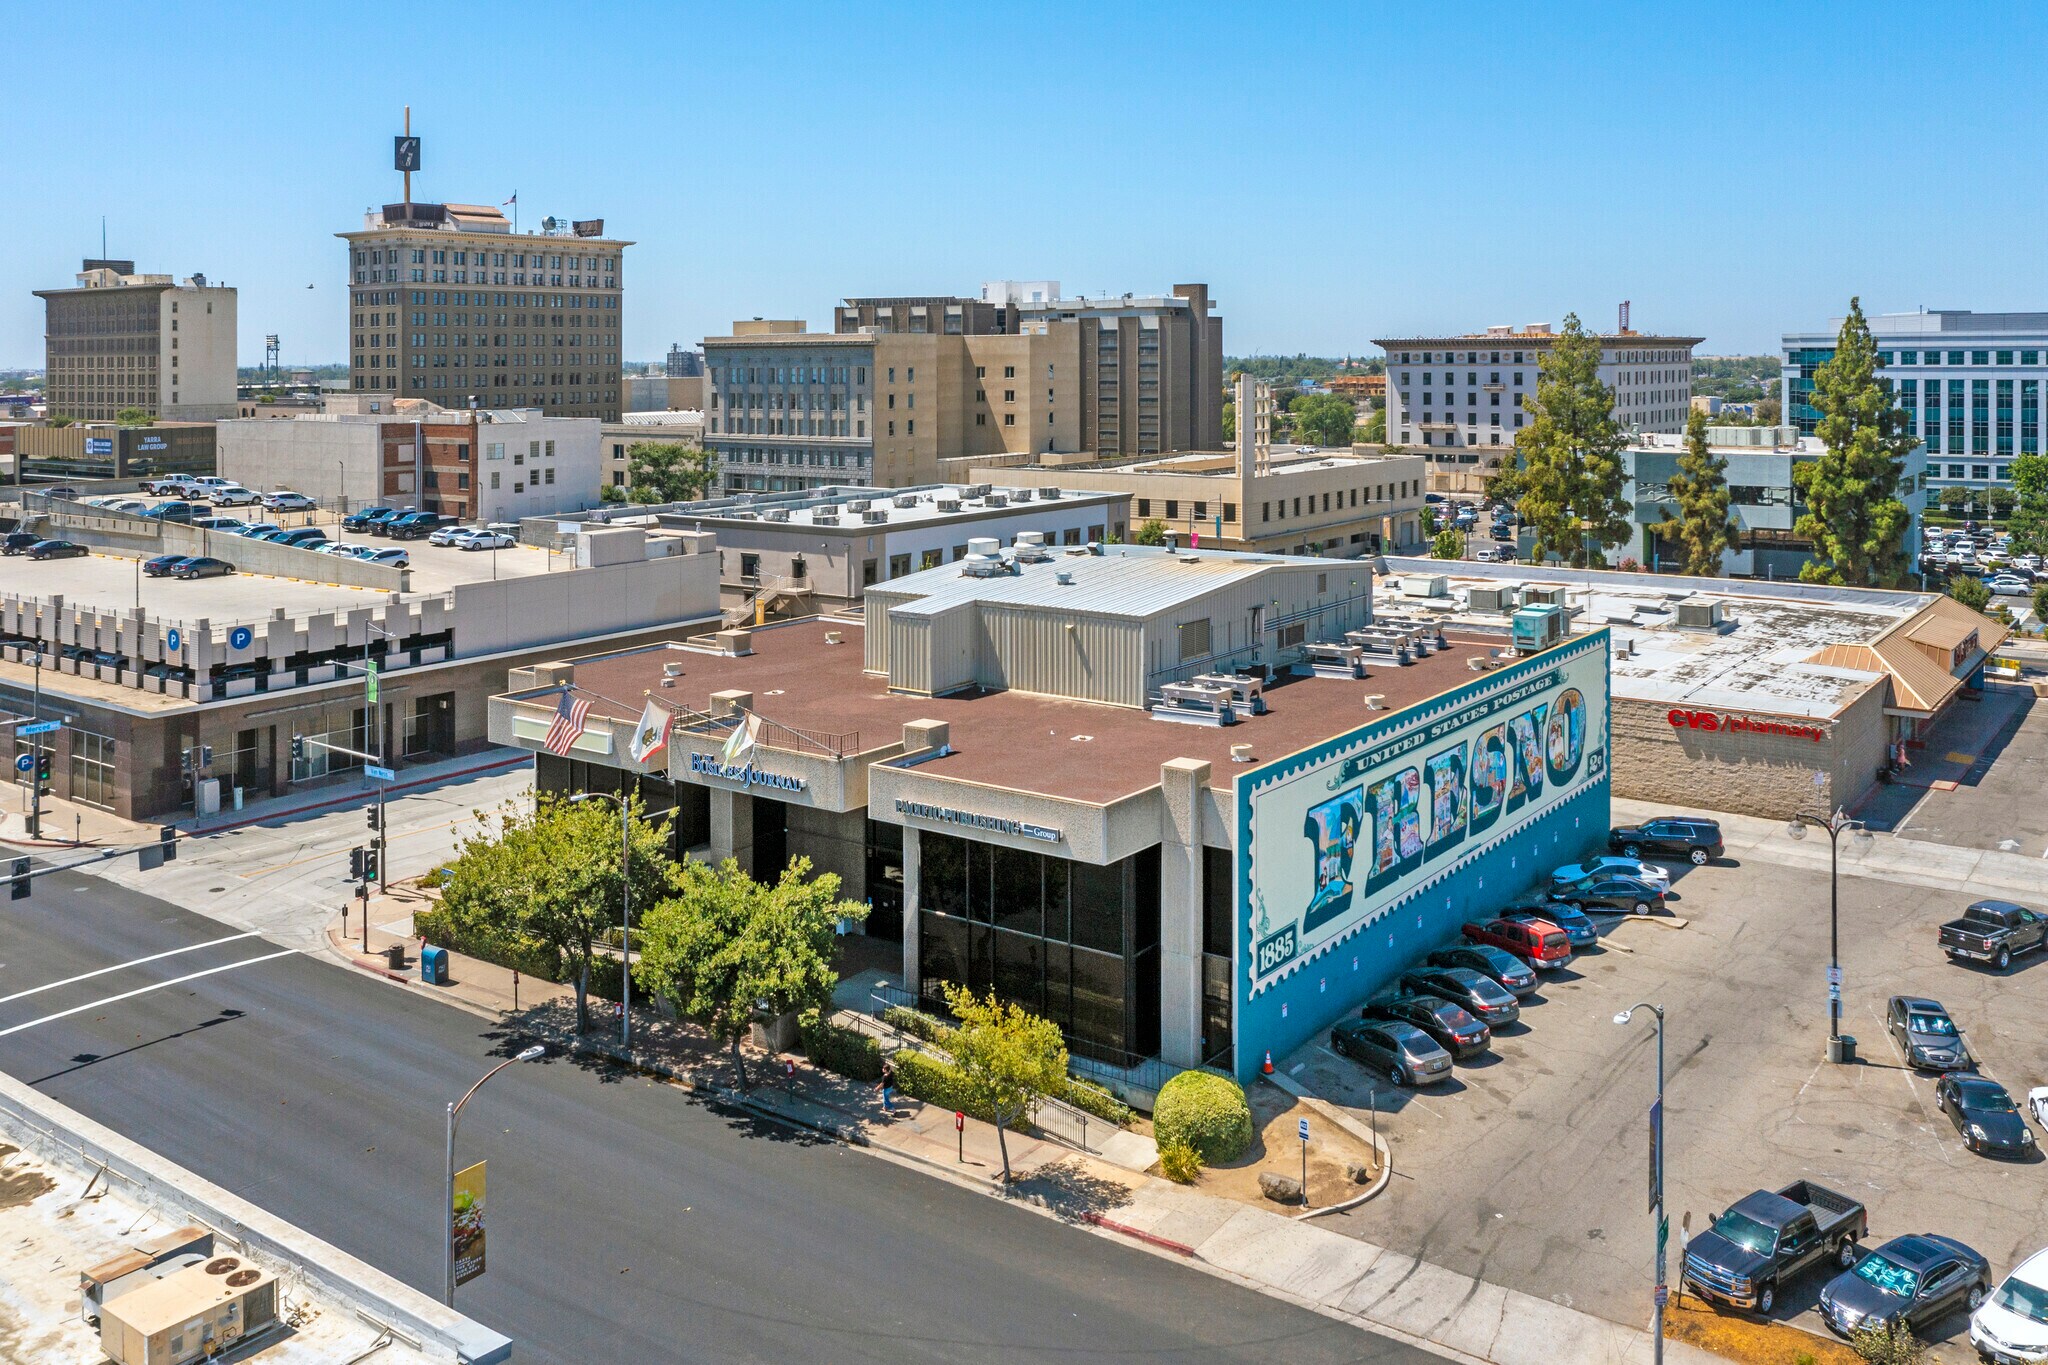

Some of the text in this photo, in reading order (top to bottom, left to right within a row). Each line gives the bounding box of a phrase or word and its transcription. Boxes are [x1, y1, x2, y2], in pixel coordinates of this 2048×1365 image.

[137, 443, 168, 451] LAW GROUP
[170, 634, 177, 646] P
[236, 633, 245, 645] P
[25, 724, 51, 733] Merced
[1355, 675, 1553, 771] UNITED STATES POSTAGE
[21, 758, 29, 769] P
[1303, 687, 1587, 936] FRESNO
[895, 798, 1056, 841] PACIFIC PUBLISHING Group
[1260, 930, 1294, 973] 1885
